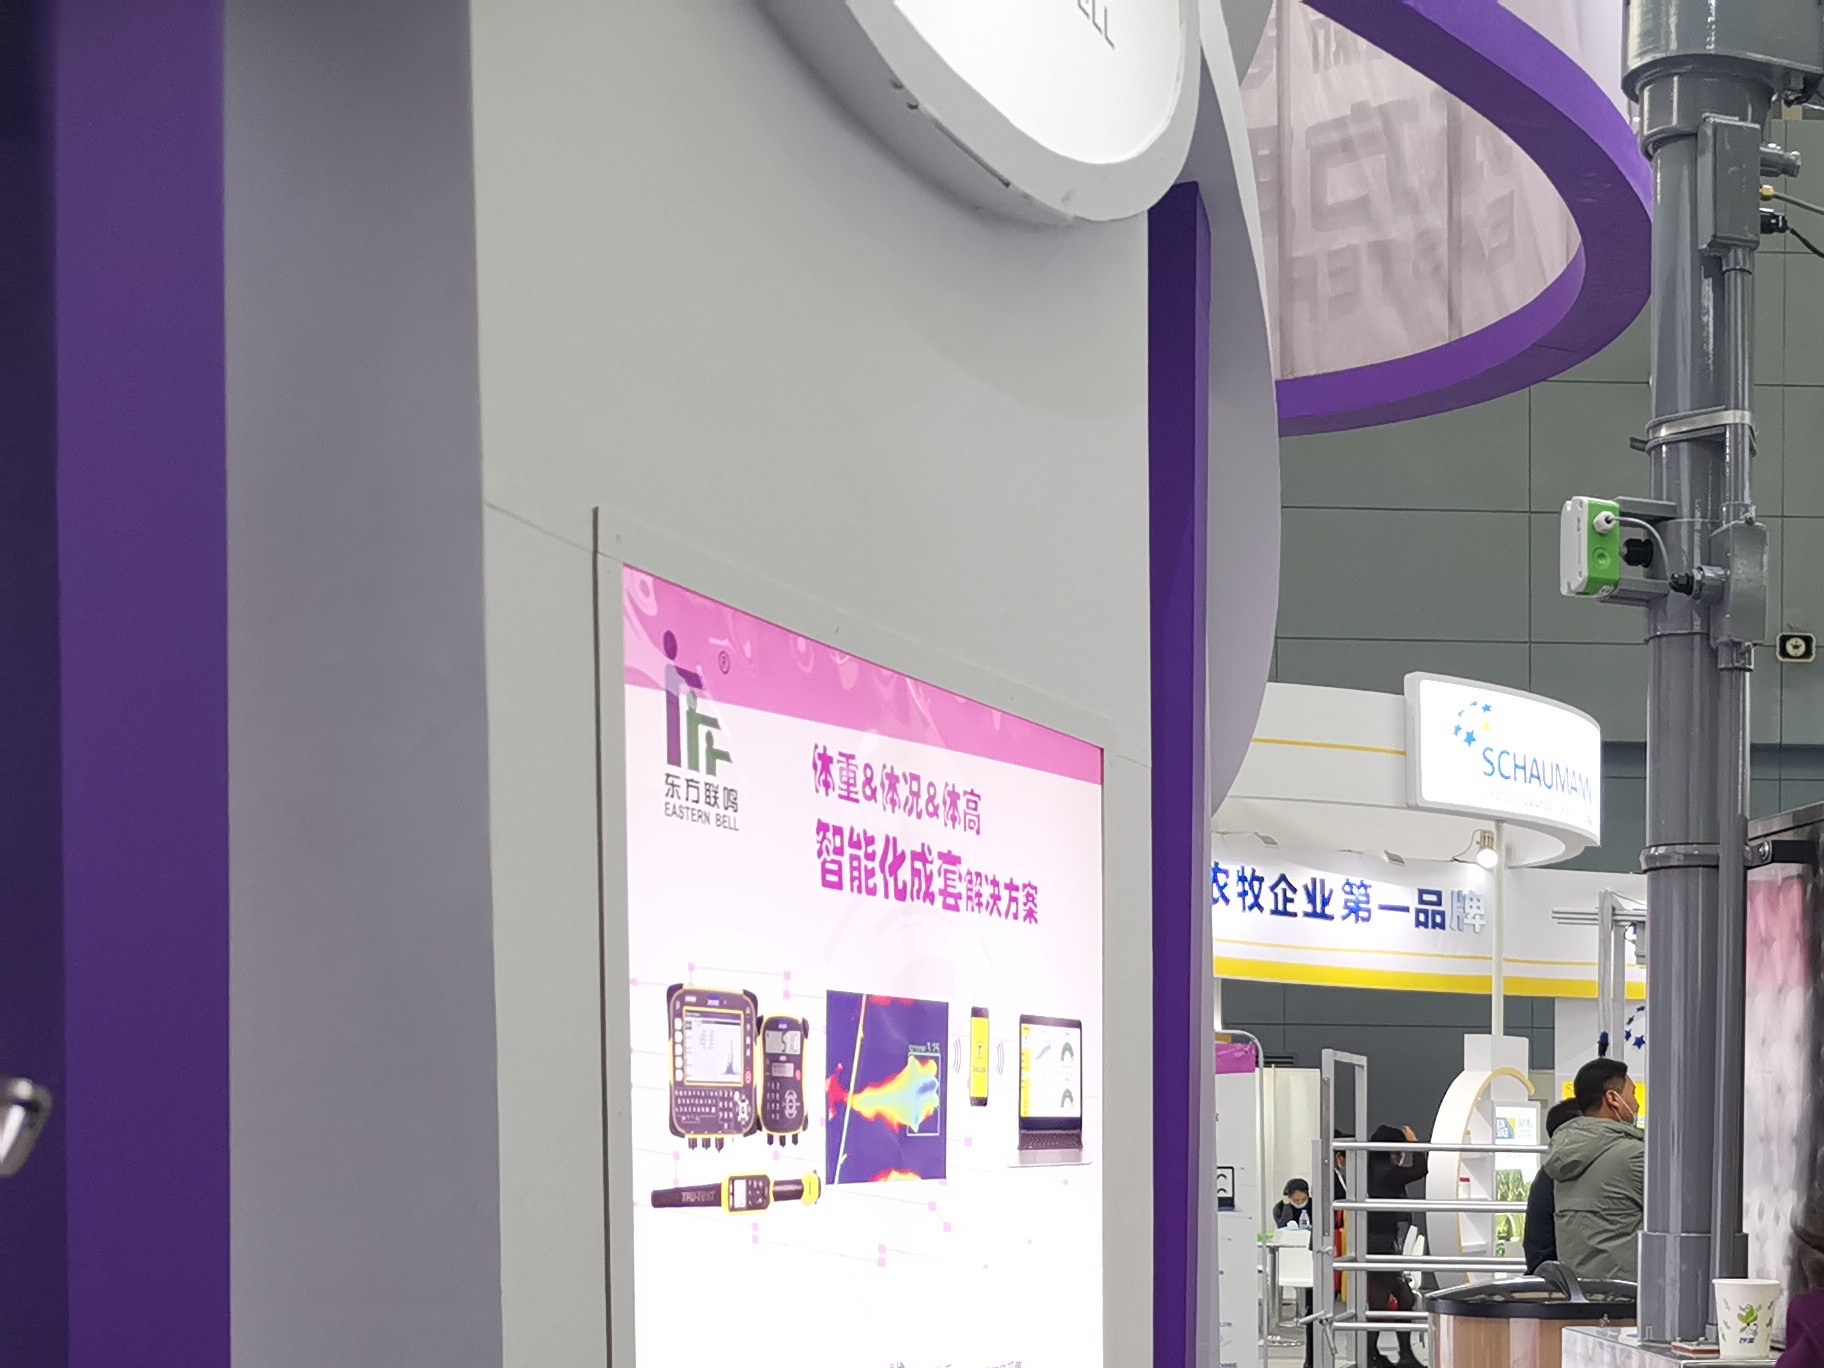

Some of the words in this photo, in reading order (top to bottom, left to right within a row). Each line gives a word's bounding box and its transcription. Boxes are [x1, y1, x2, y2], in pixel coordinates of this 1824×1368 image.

[664, 773, 740, 814] 东方联鸣
[812, 743, 982, 836] 体重&体况&体高
[1481, 746, 1593, 805] SCHAUMANN
[664, 802, 711, 826] EASTERN
[715, 812, 740, 832] BELL
[815, 818, 1040, 925] 智能化成套解决方案
